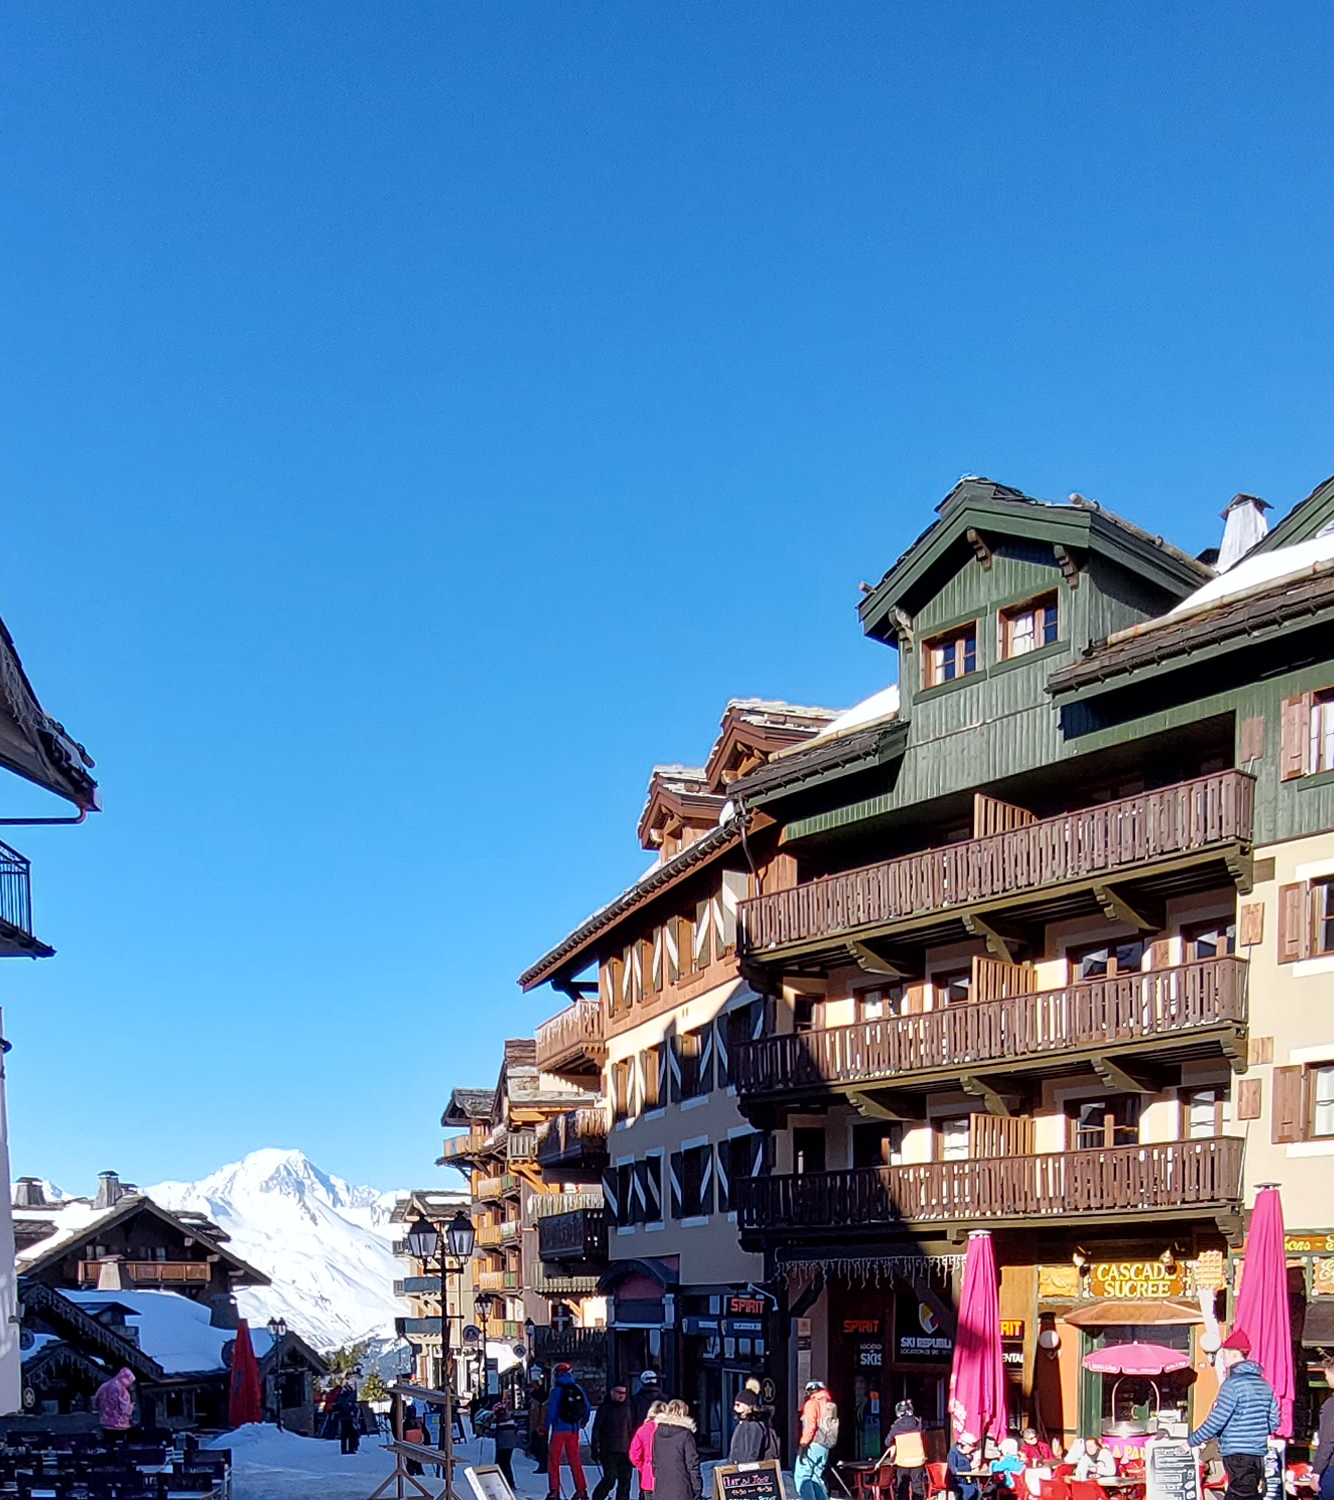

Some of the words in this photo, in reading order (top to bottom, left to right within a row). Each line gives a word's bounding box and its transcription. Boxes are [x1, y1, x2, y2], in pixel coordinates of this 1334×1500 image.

[731, 1298, 765, 1314] SPIRIT
[843, 1320, 879, 1333] SPIRIT
[1000, 1321, 1022, 1336] RIT
[900, 1337, 915, 1348] SKI
[917, 1337, 952, 1348] REPUBLI
[1002, 1353, 1024, 1363] ENTAL
